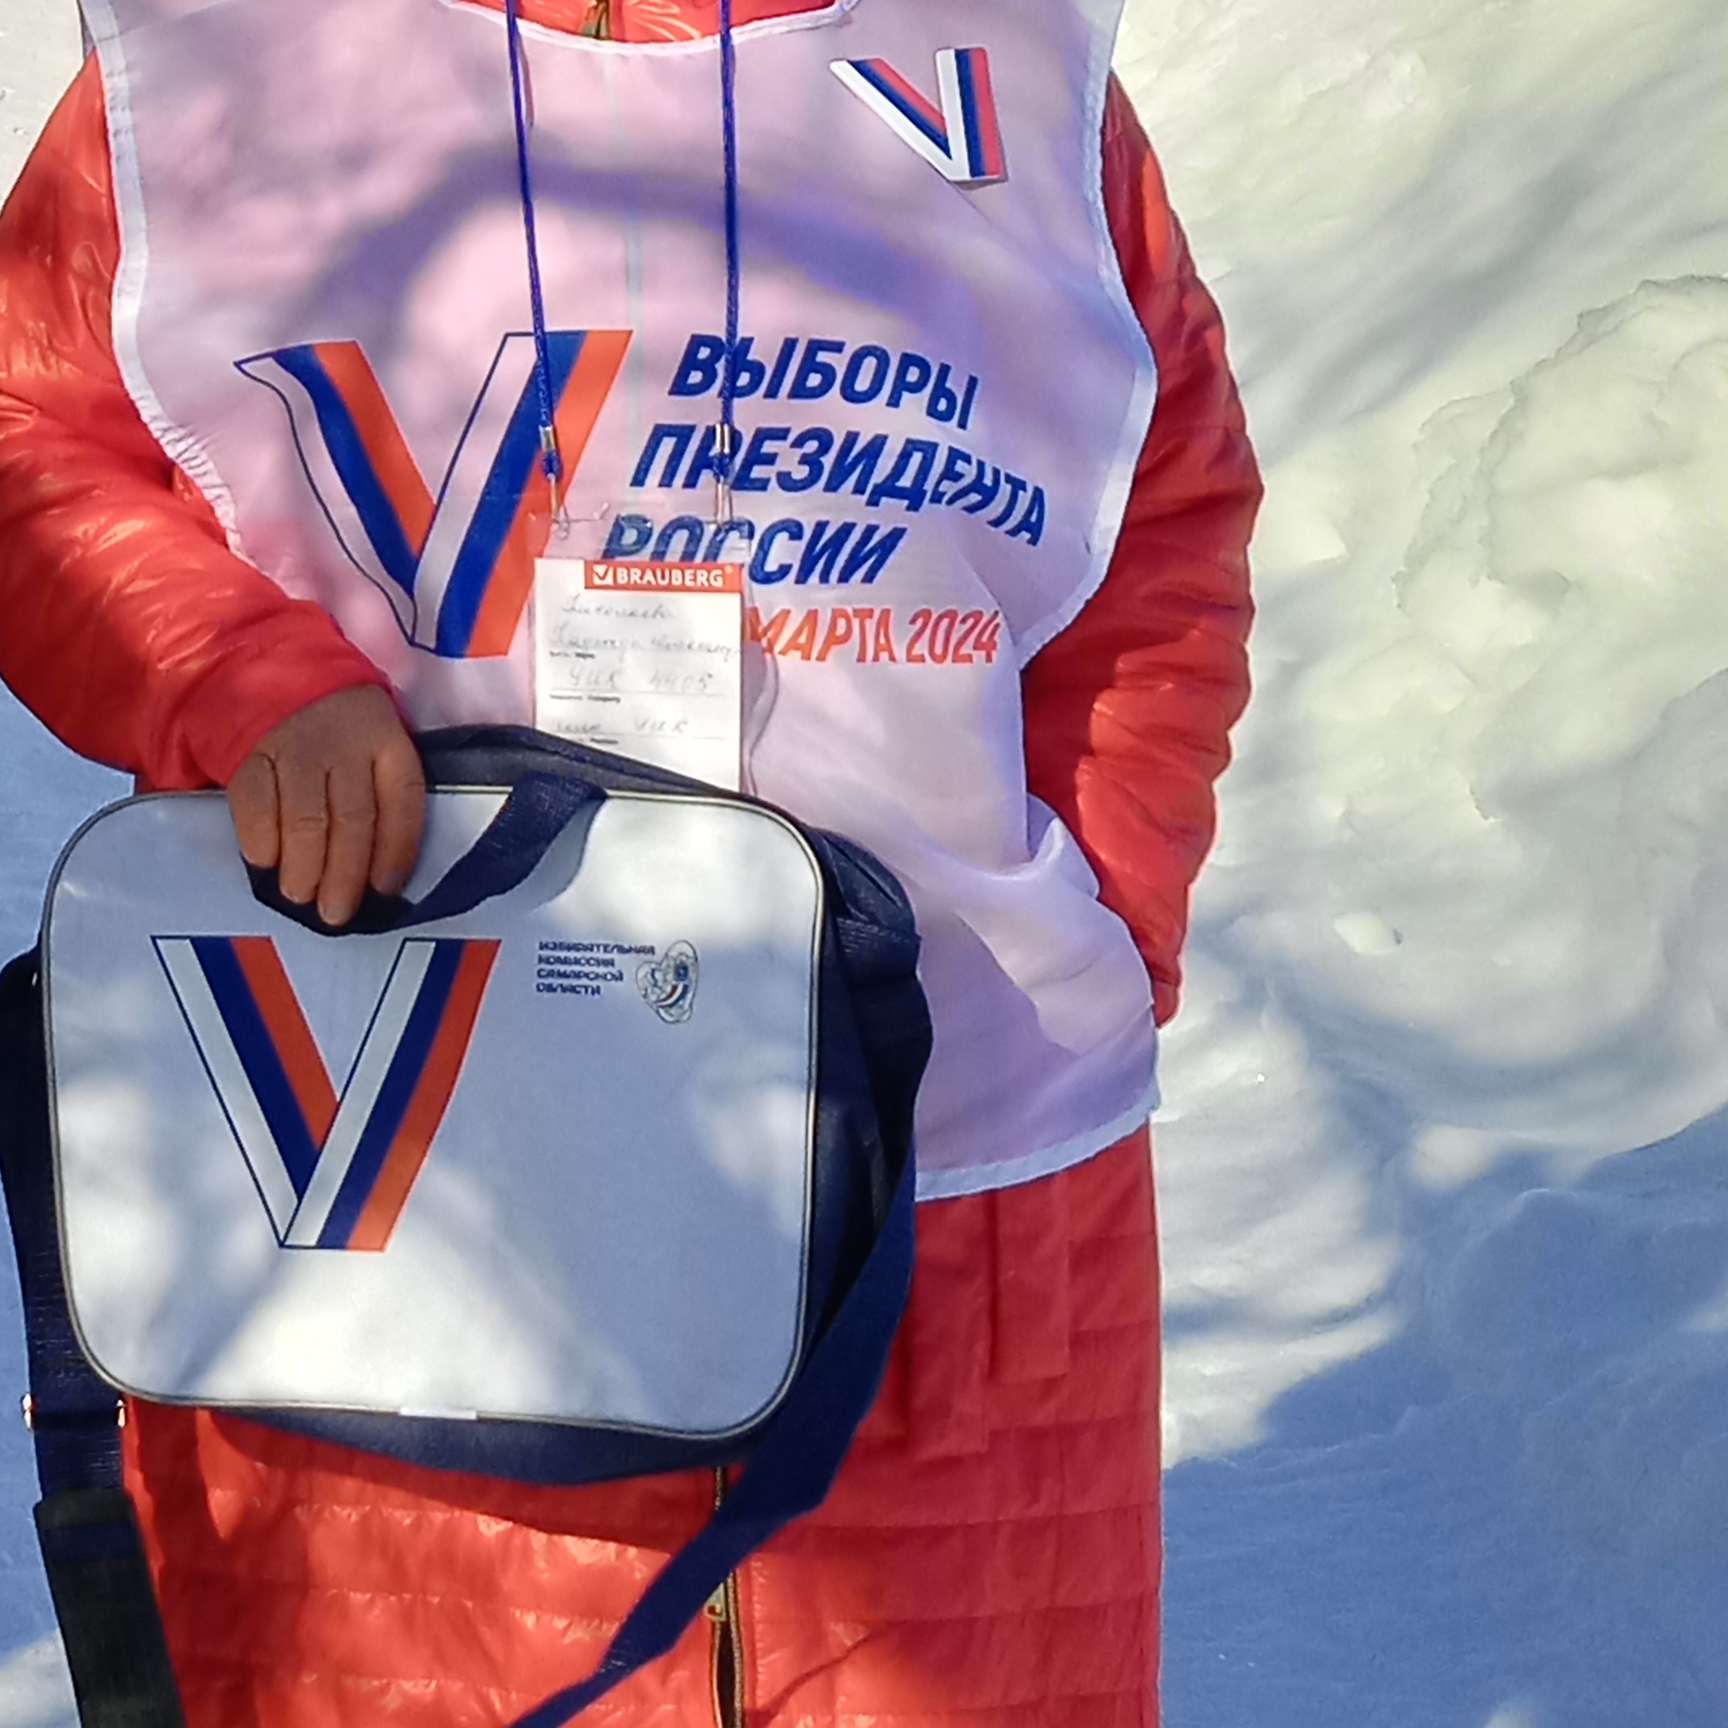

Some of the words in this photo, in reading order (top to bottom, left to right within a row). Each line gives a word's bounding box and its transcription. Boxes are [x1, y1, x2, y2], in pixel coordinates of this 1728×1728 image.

[668, 333, 979, 430] ВЫБОРЫ
[630, 423, 1047, 547] ПРЕЗИДЕНТА
[616, 568, 723, 587] BRAUBERG
[906, 606, 1000, 664] 2024
[538, 941, 655, 955] ИЗБИРАТЕЛЬНАЯ
[538, 955, 615, 967] КОМИССИЯ
[536, 969, 624, 981] САМАРСКОЙ
[536, 983, 601, 996] ОБЛАСТИ
